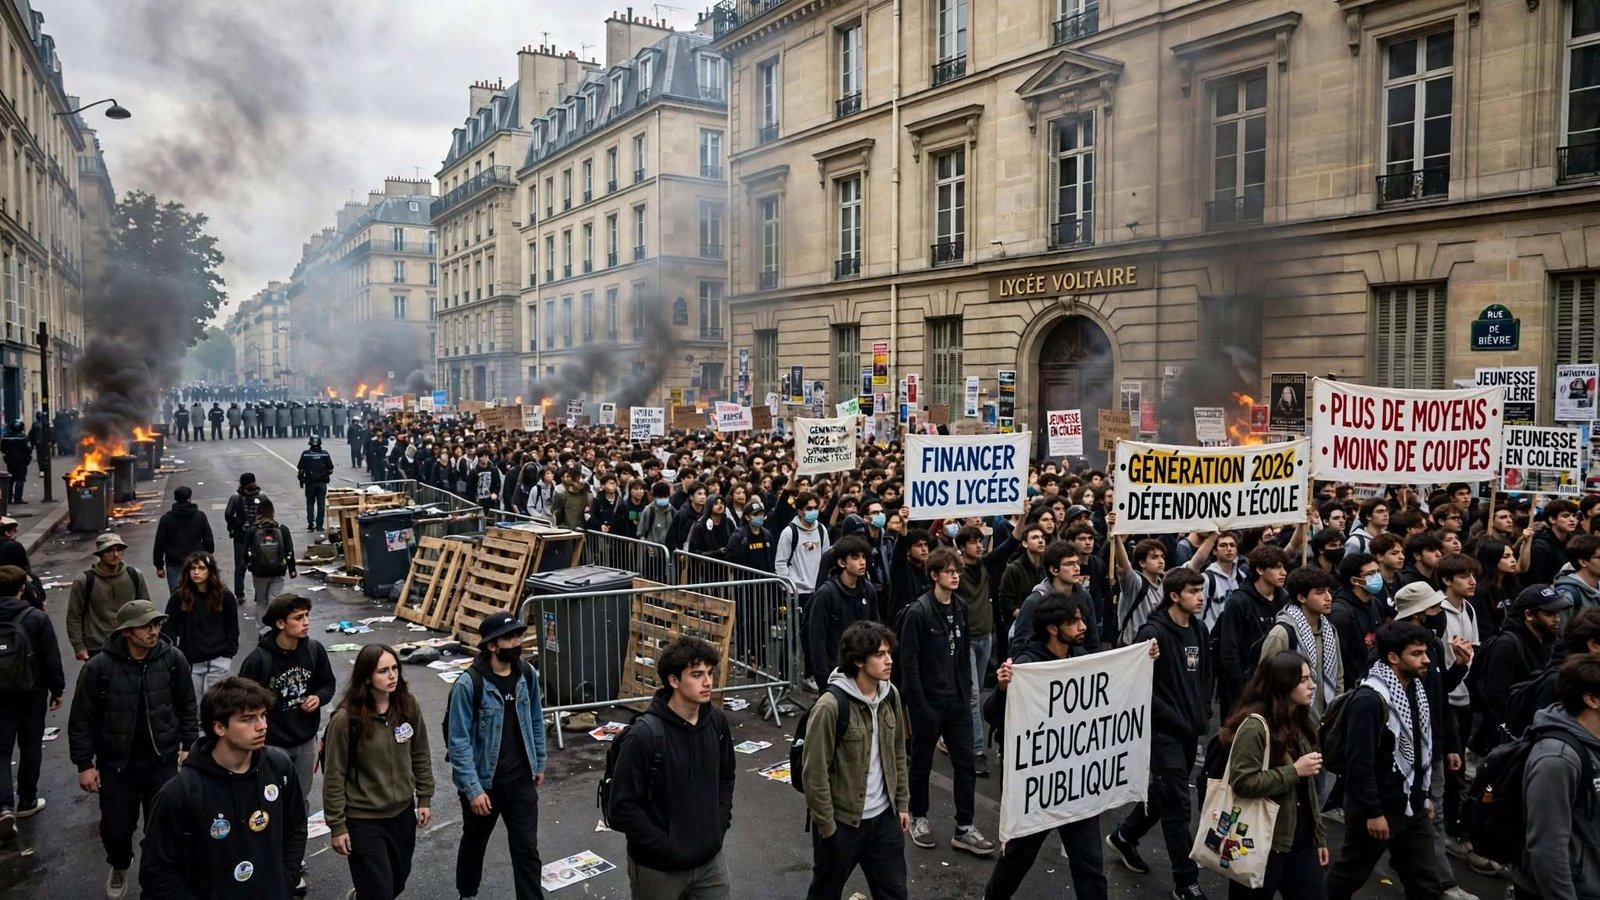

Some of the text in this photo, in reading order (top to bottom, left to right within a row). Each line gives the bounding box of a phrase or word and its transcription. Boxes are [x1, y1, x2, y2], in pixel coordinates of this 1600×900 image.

[1000, 266, 1137, 296] LYCÉE VOLTAIRE
[1489, 325, 1500, 333] DE
[1476, 371, 1536, 386] JEUNESSE
[1331, 392, 1487, 432] PLUS DE MOYENS
[1333, 435, 1491, 472] MOINS DE COUPES
[1507, 430, 1577, 449] JEUNESSE
[922, 444, 1015, 473] FINANCER
[1128, 449, 1294, 483] GÉNÉRATION 2026
[1506, 448, 1577, 468] EN COLÈRE
[912, 472, 1019, 507] NOS LYCÉES
[1128, 483, 1299, 520] DÉFENDONS L'ÉCOLE
[1049, 672, 1109, 717] POUR
[1016, 705, 1144, 771] L'ÉDUCATION
[1025, 751, 1128, 814] PUBLIQUE
